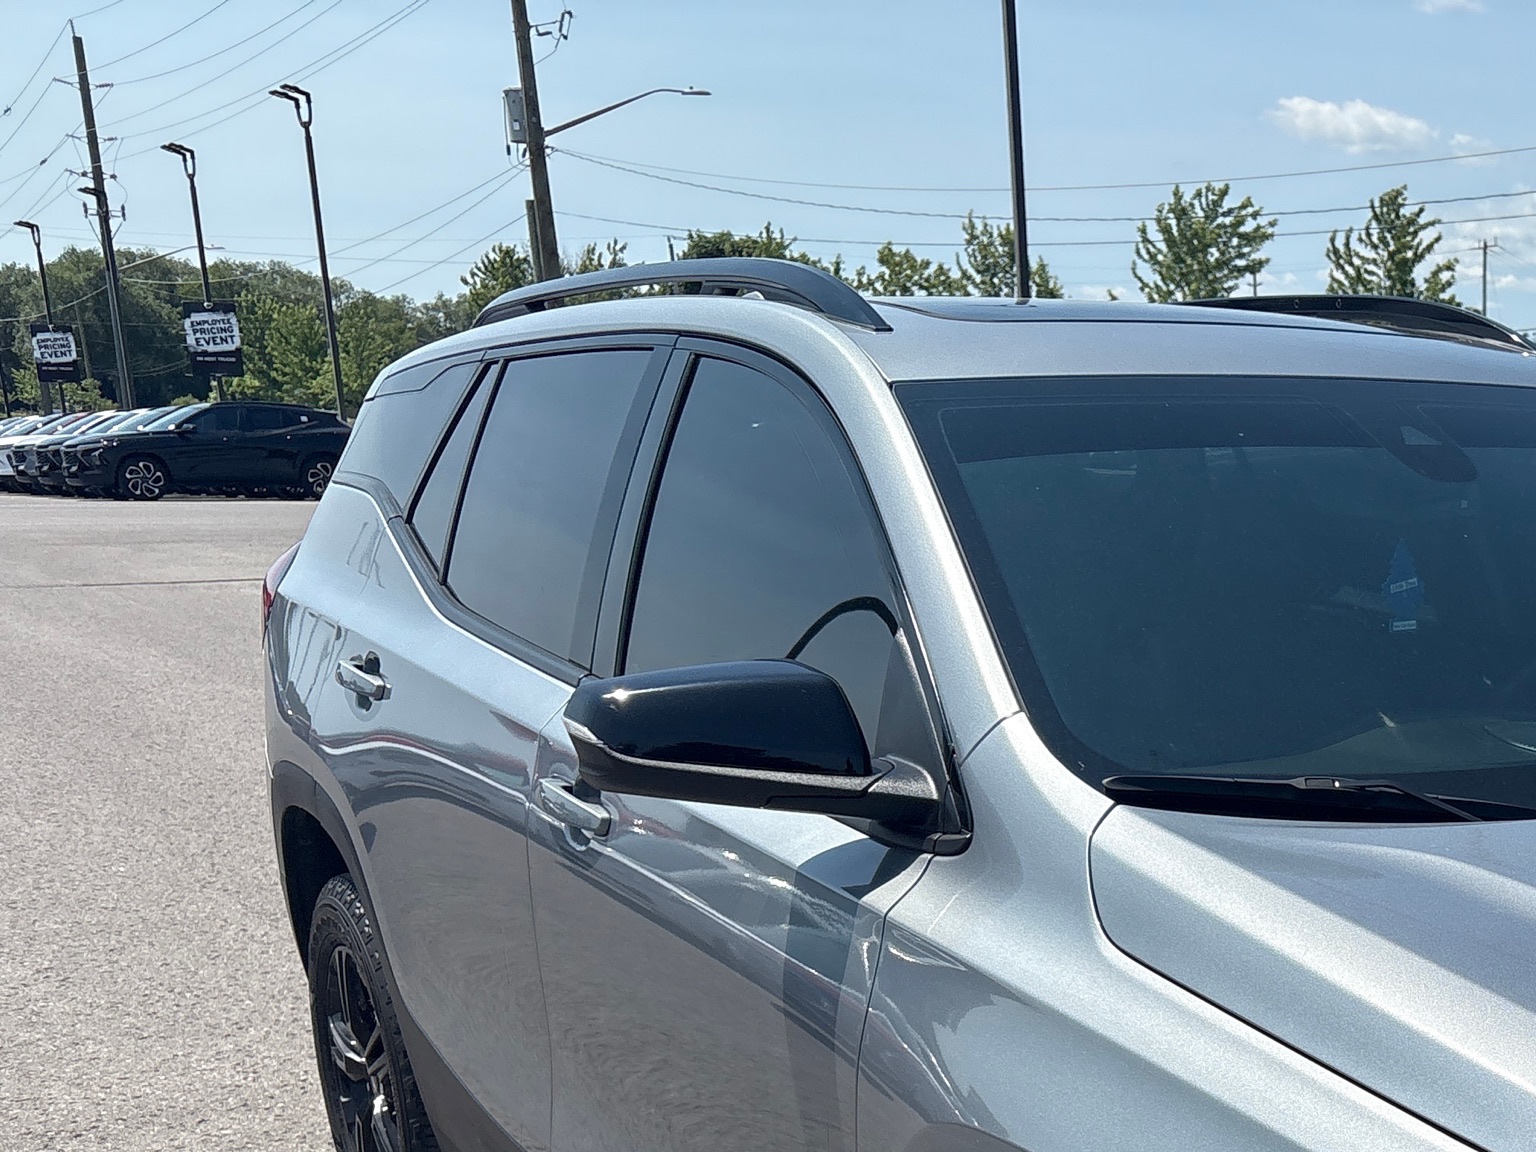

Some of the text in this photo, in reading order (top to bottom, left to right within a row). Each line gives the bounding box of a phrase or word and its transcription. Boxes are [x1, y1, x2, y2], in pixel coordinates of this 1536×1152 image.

[190, 318, 233, 328] EMPLOYEE
[192, 325, 234, 336] PRICING
[36, 336, 69, 345] EMPLOYEE
[194, 335, 236, 347] EVENT
[38, 343, 72, 351] PRICING
[40, 349, 73, 359] EVENT
